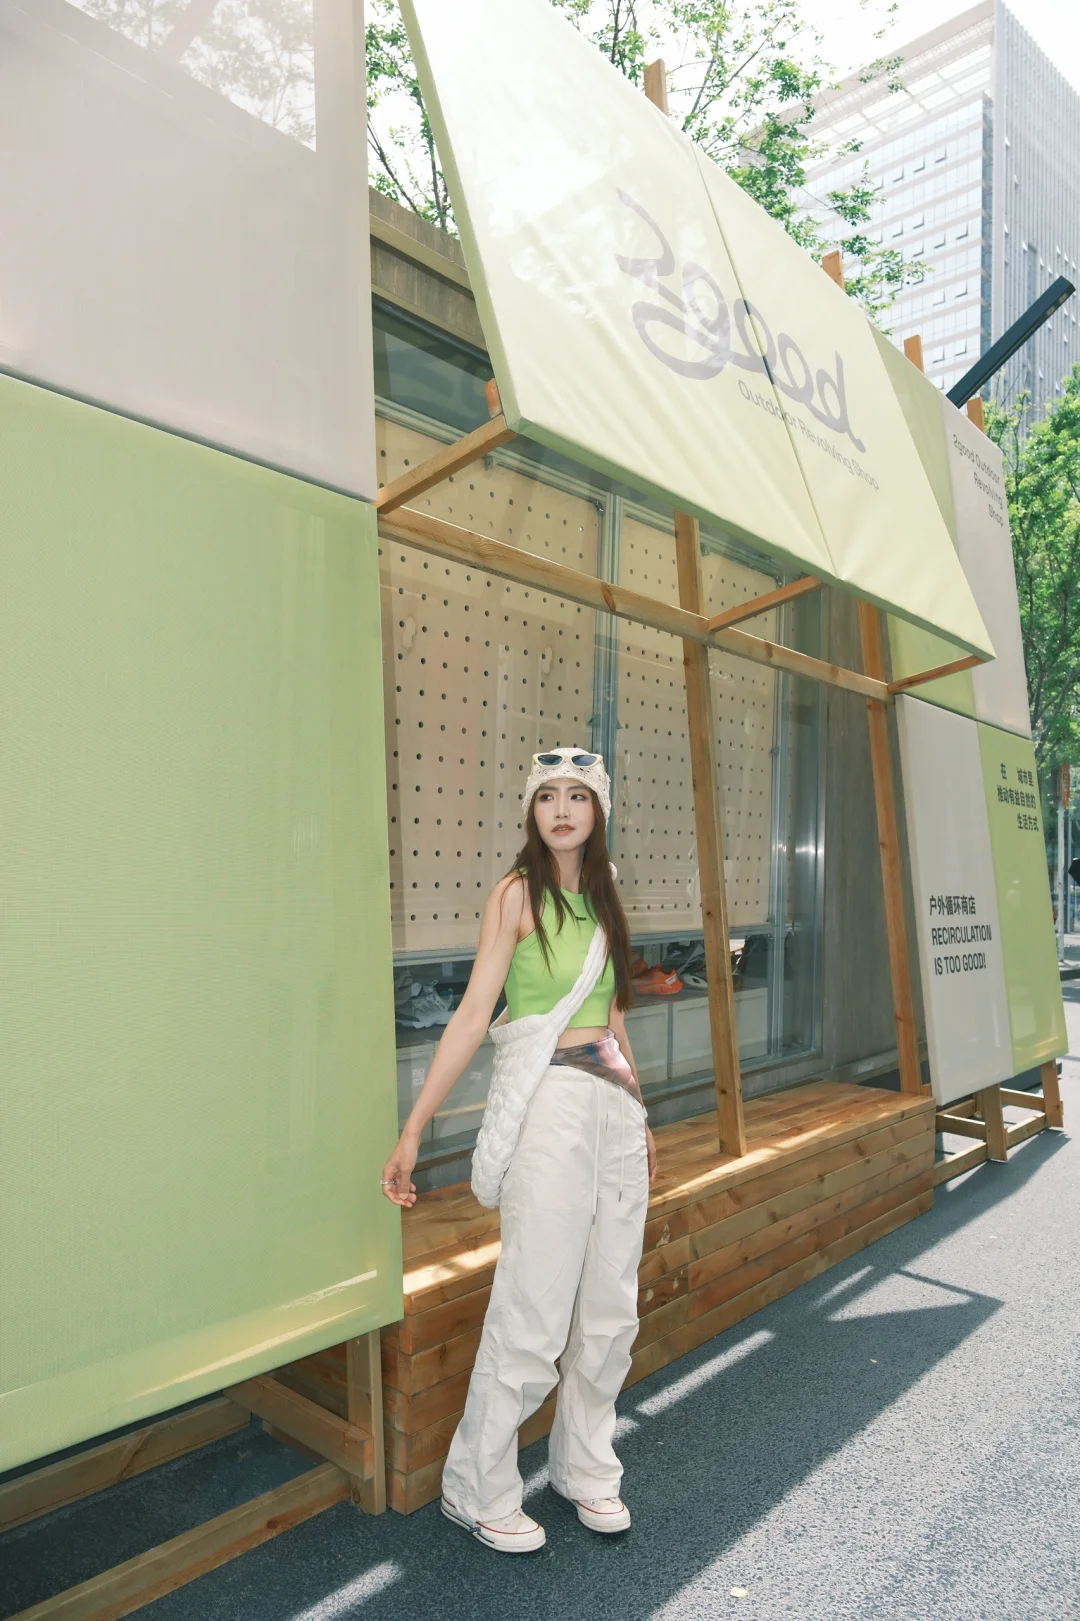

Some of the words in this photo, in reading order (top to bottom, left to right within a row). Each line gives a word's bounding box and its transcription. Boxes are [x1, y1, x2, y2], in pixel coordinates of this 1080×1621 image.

[737, 379, 800, 430] Outdoor
[797, 417, 855, 475] Revolving
[851, 458, 880, 492] Shop
[953, 433, 976, 463] 2good
[975, 453, 1000, 485] Outdoor
[973, 471, 1003, 510] Revolving
[988, 503, 1004, 528] Shop
[1000, 762, 1007, 780] 在
[1016, 812, 1039, 832] 生活方式
[929, 894, 976, 916] 户外循环商店
[931, 924, 992, 946] RECIRCULATION
[934, 957, 943, 976] IS
[943, 955, 961, 974] TOO
[962, 952, 987, 972] GOOD!
